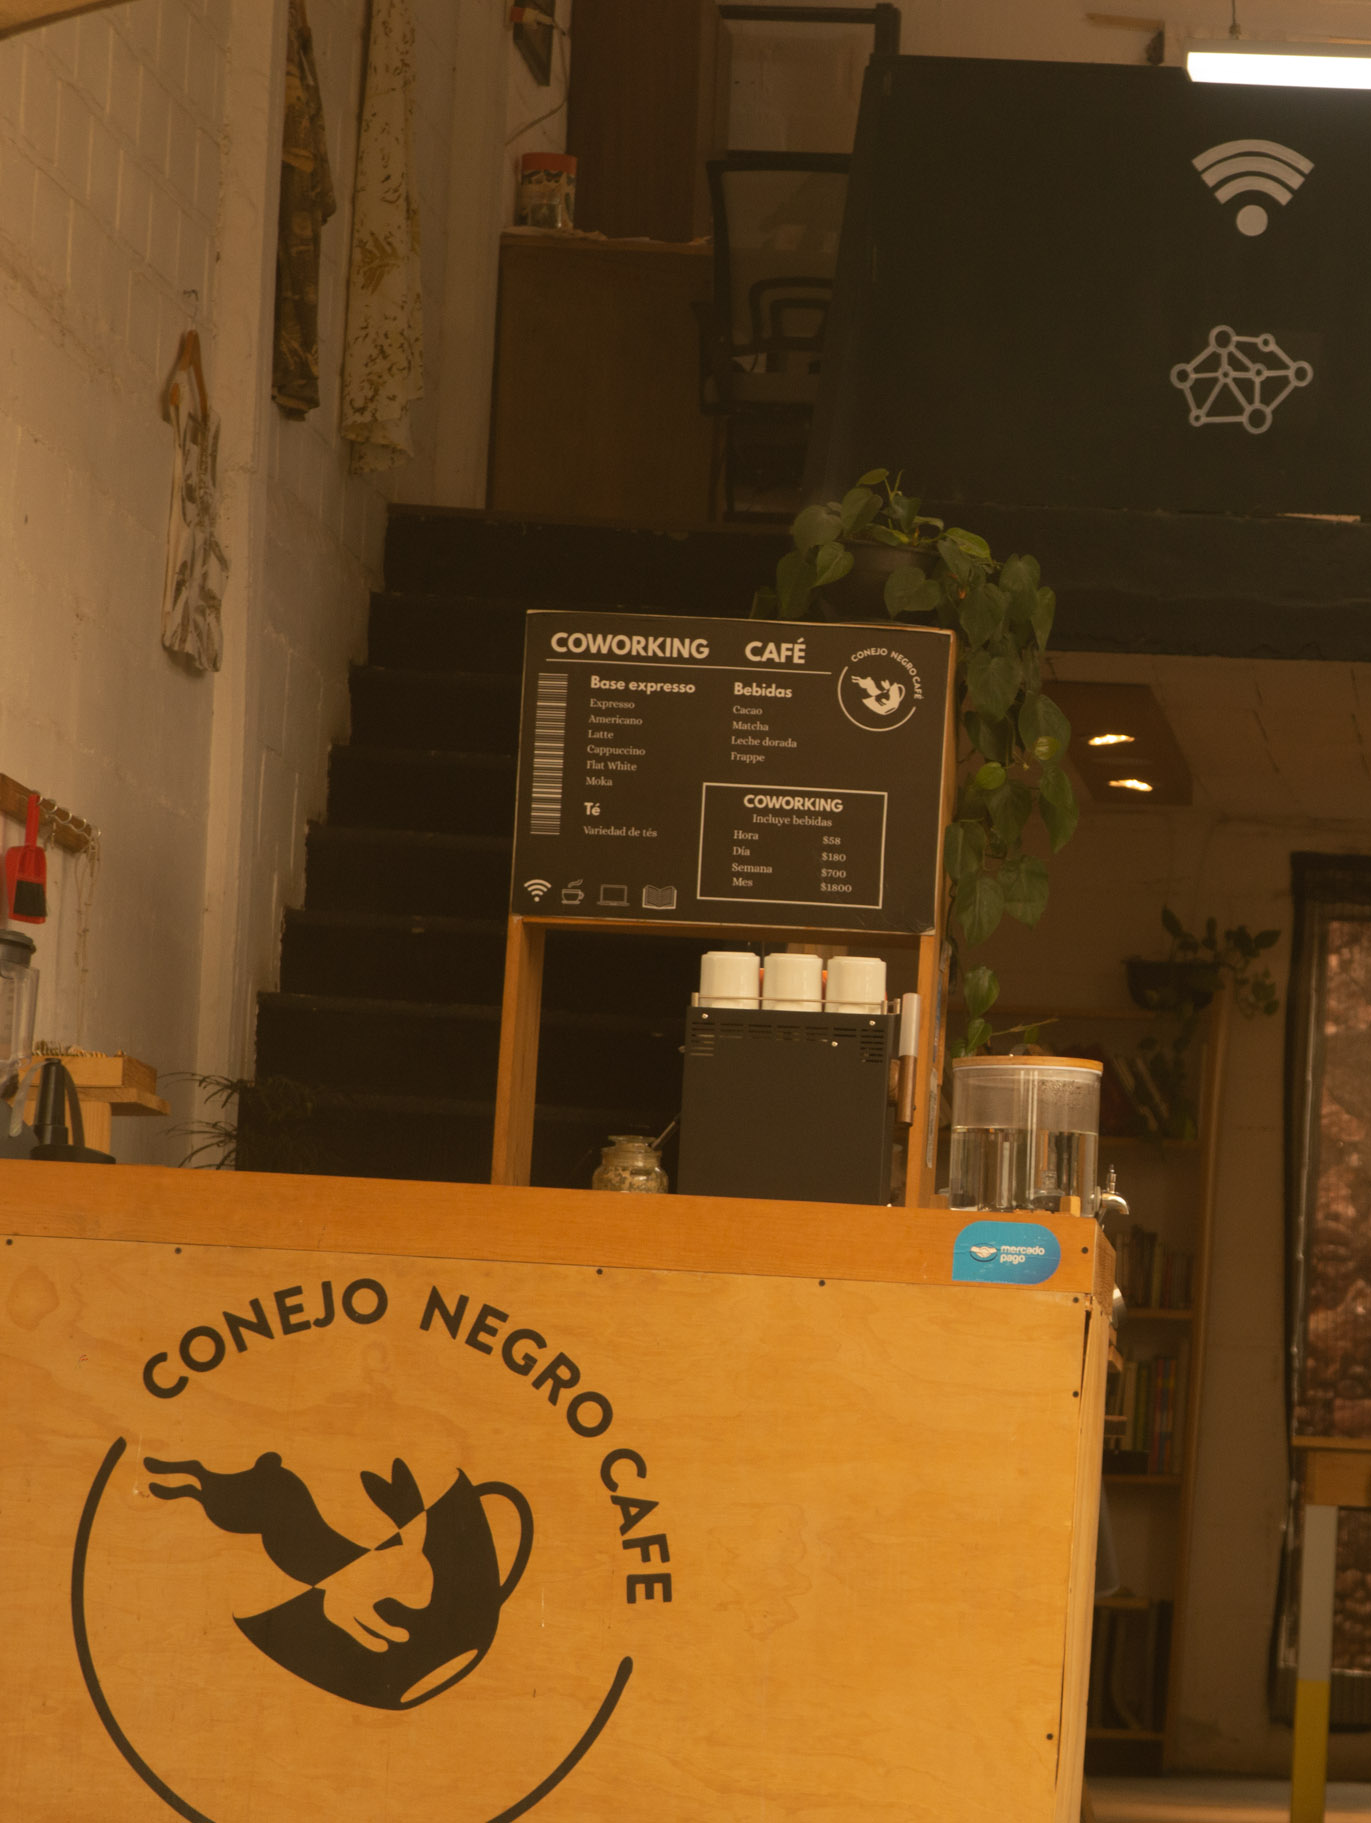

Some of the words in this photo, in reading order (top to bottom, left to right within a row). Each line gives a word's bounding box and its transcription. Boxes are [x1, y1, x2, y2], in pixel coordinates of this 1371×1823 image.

[550, 632, 710, 660] COWORKING
[744, 637, 806, 664] CAFÉ
[850, 647, 888, 663] CONEJO
[890, 650, 917, 676] NEGRO
[590, 675, 626, 690] Base
[628, 680, 696, 695] expresso
[733, 682, 793, 698] Bebidas
[589, 698, 636, 710] Expresso
[733, 705, 763, 716] Cacao
[588, 715, 643, 726] Americano
[732, 721, 769, 732] Matcha
[588, 729, 614, 740] Latte
[731, 736, 761, 747] Leche
[762, 737, 797, 748] dorada
[587, 745, 646, 757] Cappuccino
[730, 752, 766, 764] Frappe
[586, 760, 605, 771] Flat
[607, 761, 638, 772] White
[585, 776, 613, 787] Moka
[583, 801, 601, 816] Té
[743, 794, 844, 813] COWORKING
[752, 814, 791, 827] Incluye
[792, 815, 833, 827] bebidas
[583, 825, 626, 837] Variedad
[628, 827, 641, 837] de
[642, 827, 658, 838] tés
[733, 829, 759, 840] Hora
[822, 835, 841, 846] $58
[732, 846, 751, 856] Día
[821, 852, 847, 862] $180
[731, 862, 773, 874] Semana
[821, 868, 847, 878] $700
[732, 877, 753, 887] Mes
[820, 882, 853, 893] $1800
[1000, 1245, 1045, 1256] mercado
[1000, 1254, 1026, 1264] pago
[142, 1277, 389, 1399] CONEJO
[419, 1285, 614, 1438] NEGRO
[600, 1447, 673, 1605] CAFE
